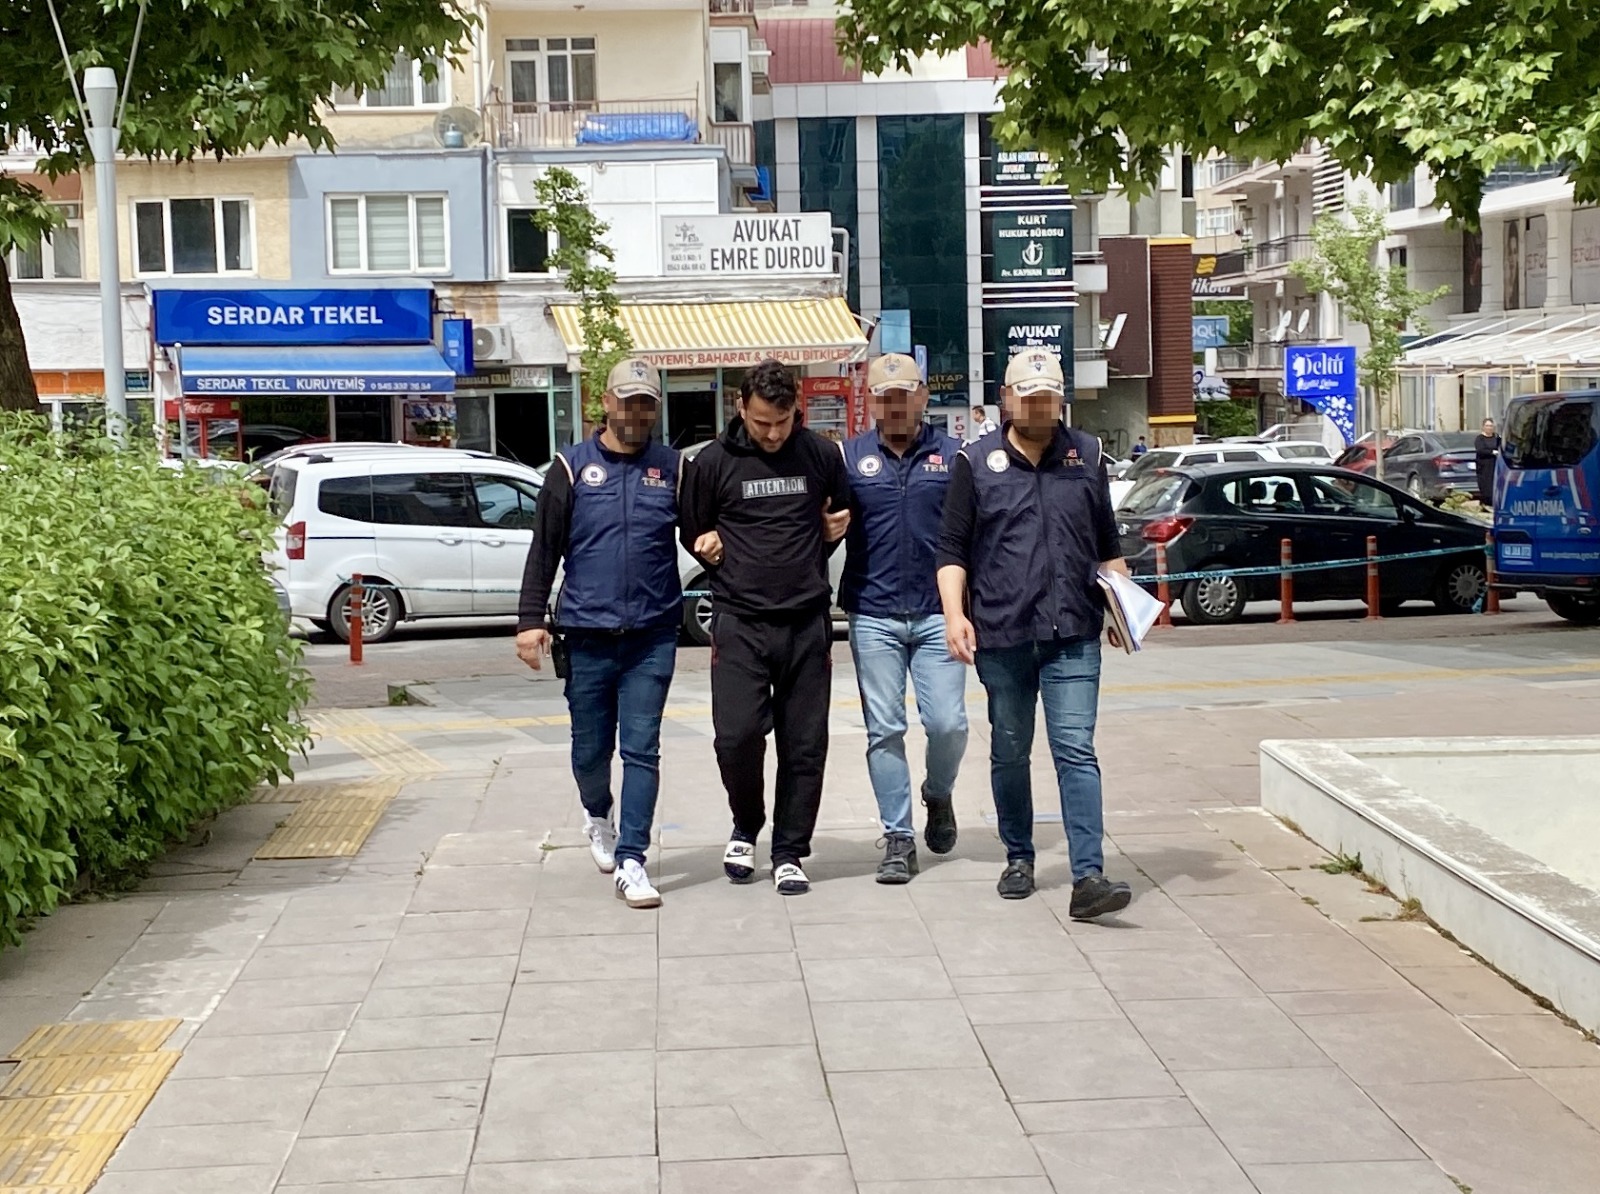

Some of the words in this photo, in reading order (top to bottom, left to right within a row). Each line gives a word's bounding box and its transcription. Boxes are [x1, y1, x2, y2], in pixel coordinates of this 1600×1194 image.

[1017, 214, 1048, 225] KURT
[732, 219, 802, 242] AVUKAT
[999, 229, 1029, 238] HUKUK
[1030, 227, 1064, 237] BÜROSU
[710, 247, 760, 271] EMRE
[765, 246, 826, 269] DURDU
[207, 306, 304, 325] SERDAR
[310, 306, 383, 325] TEKEL
[1008, 324, 1062, 339] AVUKAT
[698, 352, 751, 363] BAHARAT
[196, 378, 246, 390] SERDAR
[251, 378, 290, 390] TEKEL
[296, 377, 366, 391] KURUYEMİŞ
[928, 374, 964, 382] KİTAP
[922, 464, 948, 473] TEM
[747, 478, 804, 497] ATTENTION
[1511, 500, 1566, 516] JANDARMA
